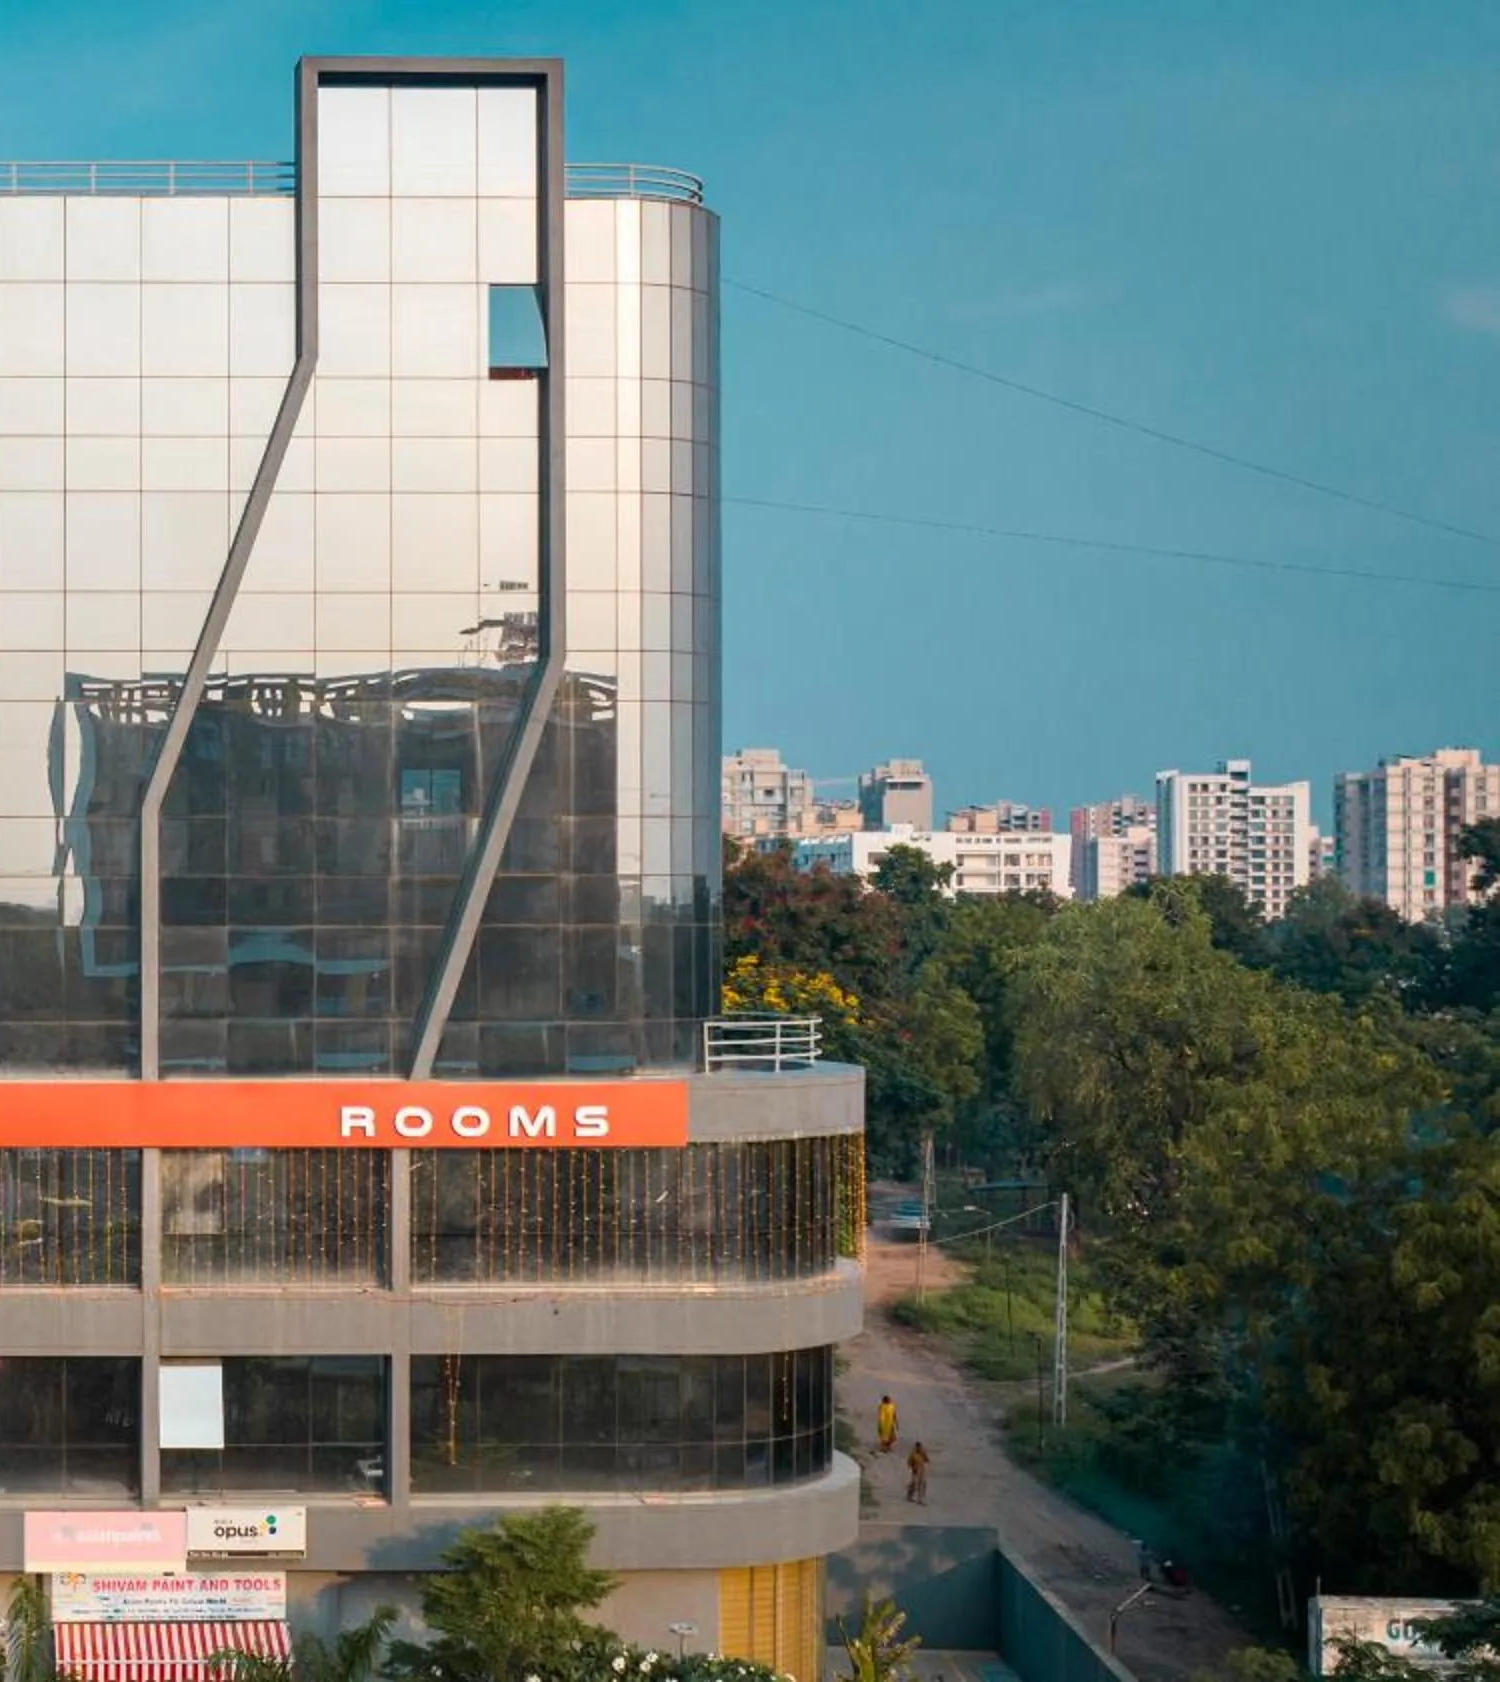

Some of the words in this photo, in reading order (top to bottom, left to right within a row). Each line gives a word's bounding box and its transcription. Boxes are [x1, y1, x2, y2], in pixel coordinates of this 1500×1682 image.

[341, 1105, 609, 1137] ROOMS
[213, 1524, 258, 1540] opus
[92, 1577, 148, 1593] SHIVAM
[151, 1577, 195, 1593] PAINT
[198, 1577, 231, 1593] AND
[234, 1577, 282, 1593] TOOLS
